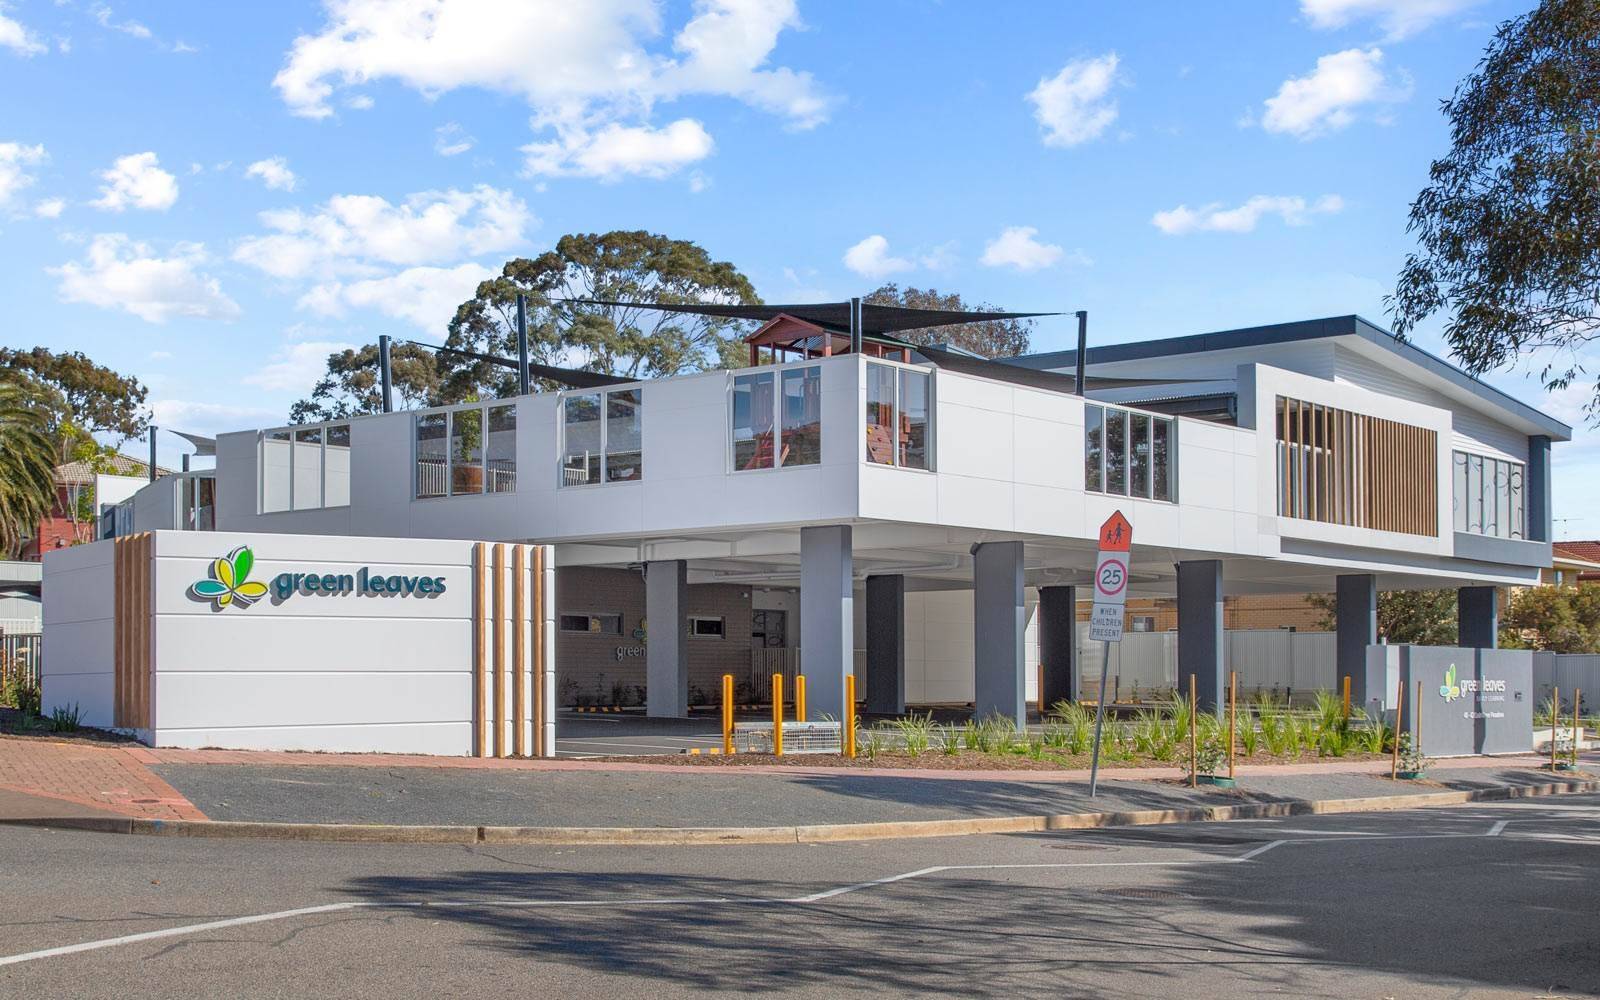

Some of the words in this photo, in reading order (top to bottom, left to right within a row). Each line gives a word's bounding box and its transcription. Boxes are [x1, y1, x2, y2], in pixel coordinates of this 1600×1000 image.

[275, 572, 354, 600] green
[361, 566, 447, 593] leaves
[1101, 569, 1121, 585] 25
[1100, 608, 1117, 616] WHEN
[1092, 617, 1122, 627] CHILDREN
[1092, 628, 1120, 637] PRESENT
[616, 646, 646, 662] green
[1482, 675, 1506, 692] leaves
